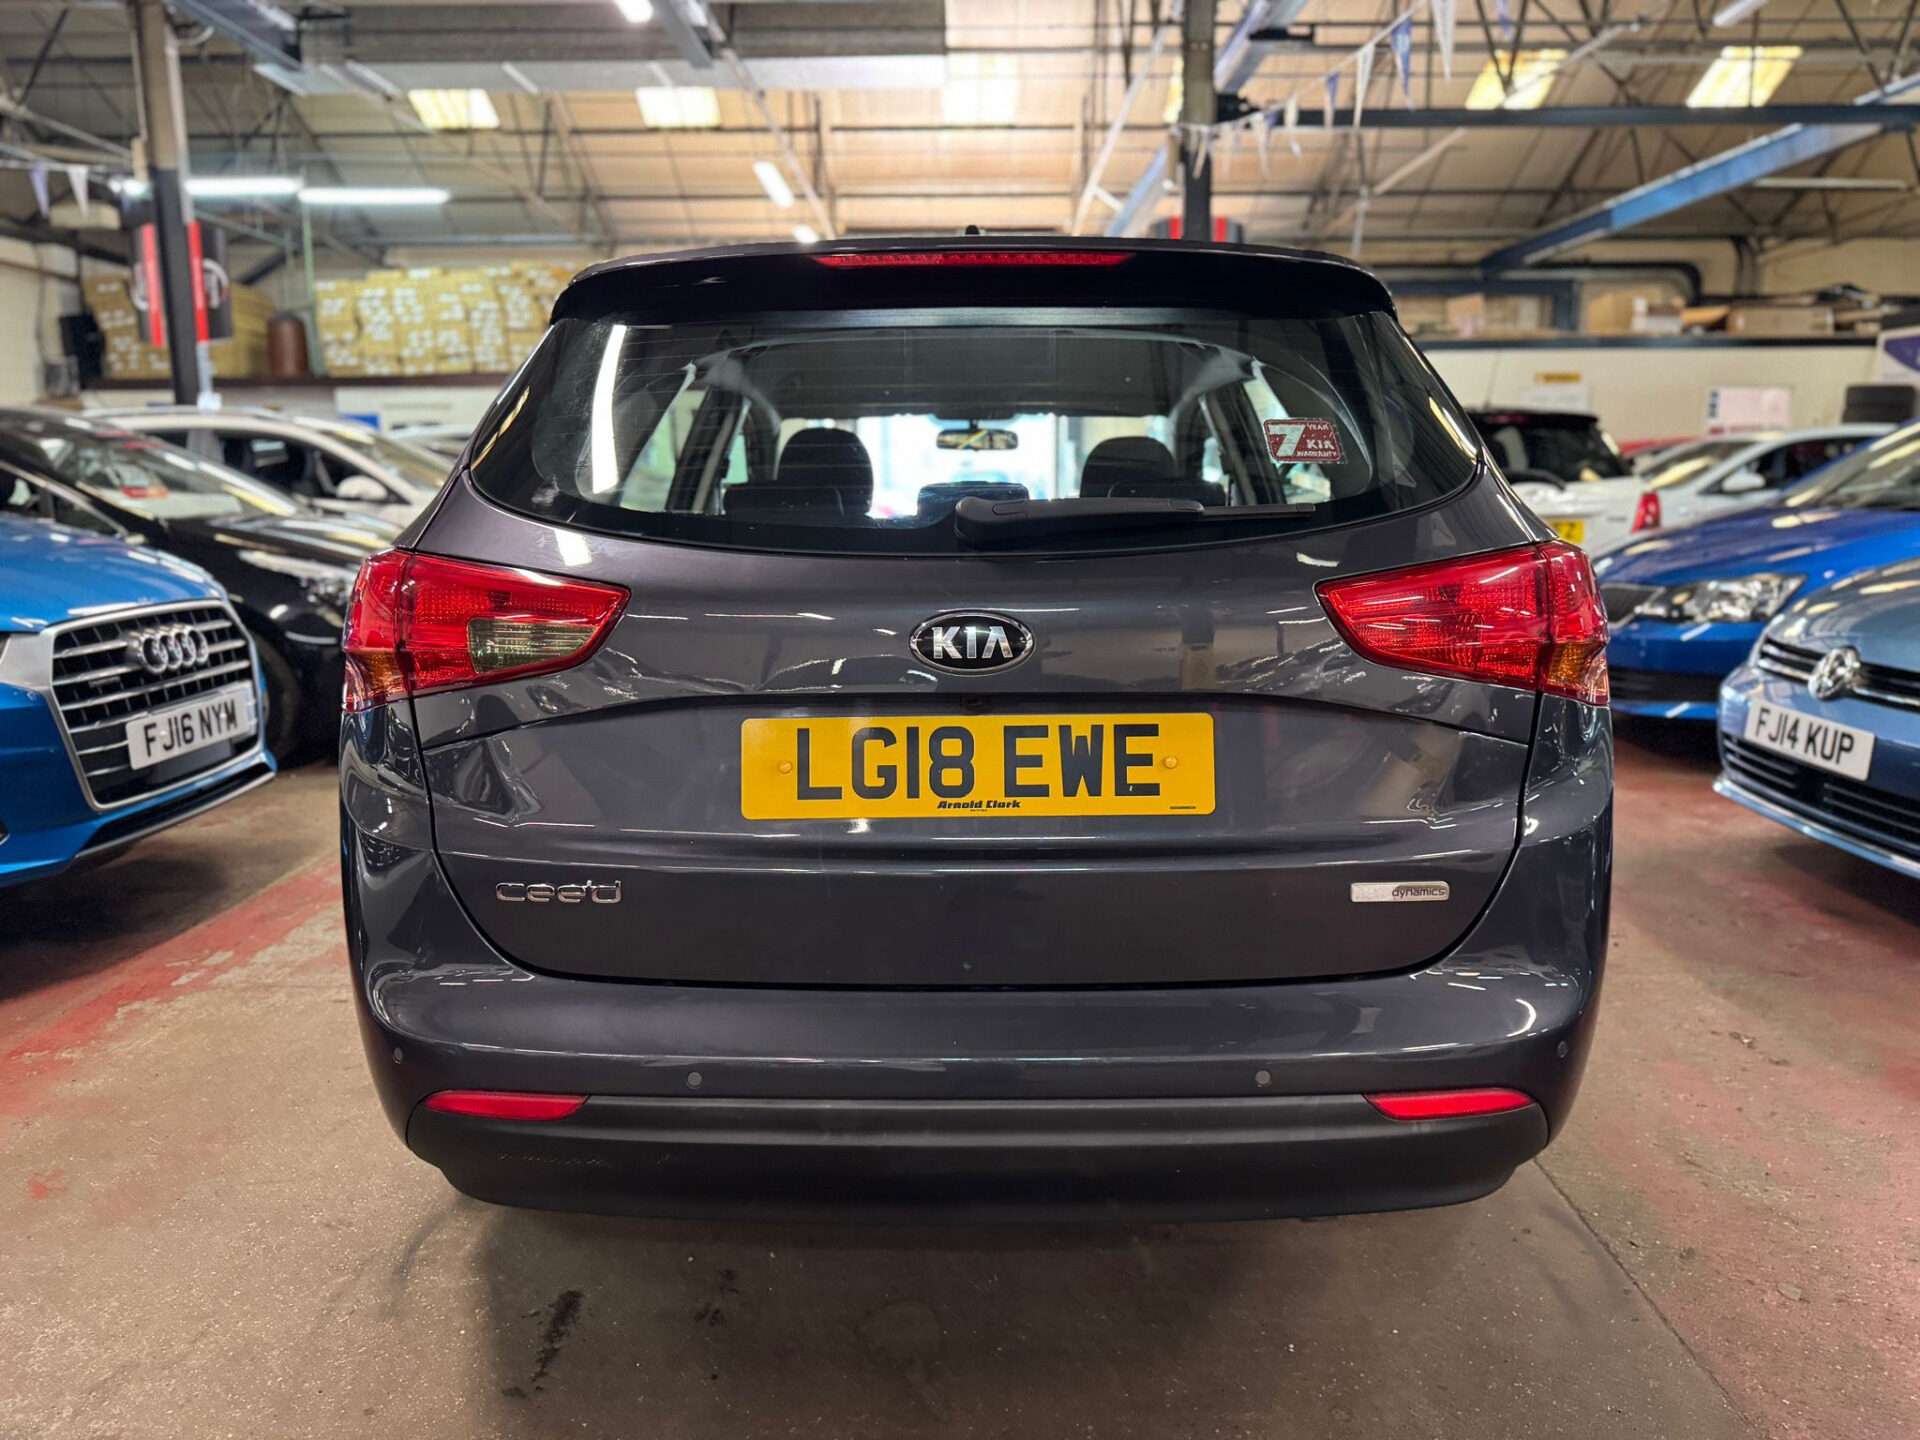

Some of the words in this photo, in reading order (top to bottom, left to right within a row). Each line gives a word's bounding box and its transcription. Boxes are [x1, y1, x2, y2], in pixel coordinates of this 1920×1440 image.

[1268, 424, 1306, 457] 7
[1306, 440, 1335, 449] KIA
[931, 626, 1014, 659] KIA
[143, 713, 194, 757] FJ16
[1755, 707, 1800, 749] FJ14
[1804, 721, 1854, 765] KUP
[797, 726, 975, 800] LG18
[1003, 723, 1161, 798] EWE
[937, 800, 983, 809] Arnold
[986, 800, 1021, 809] Clark
